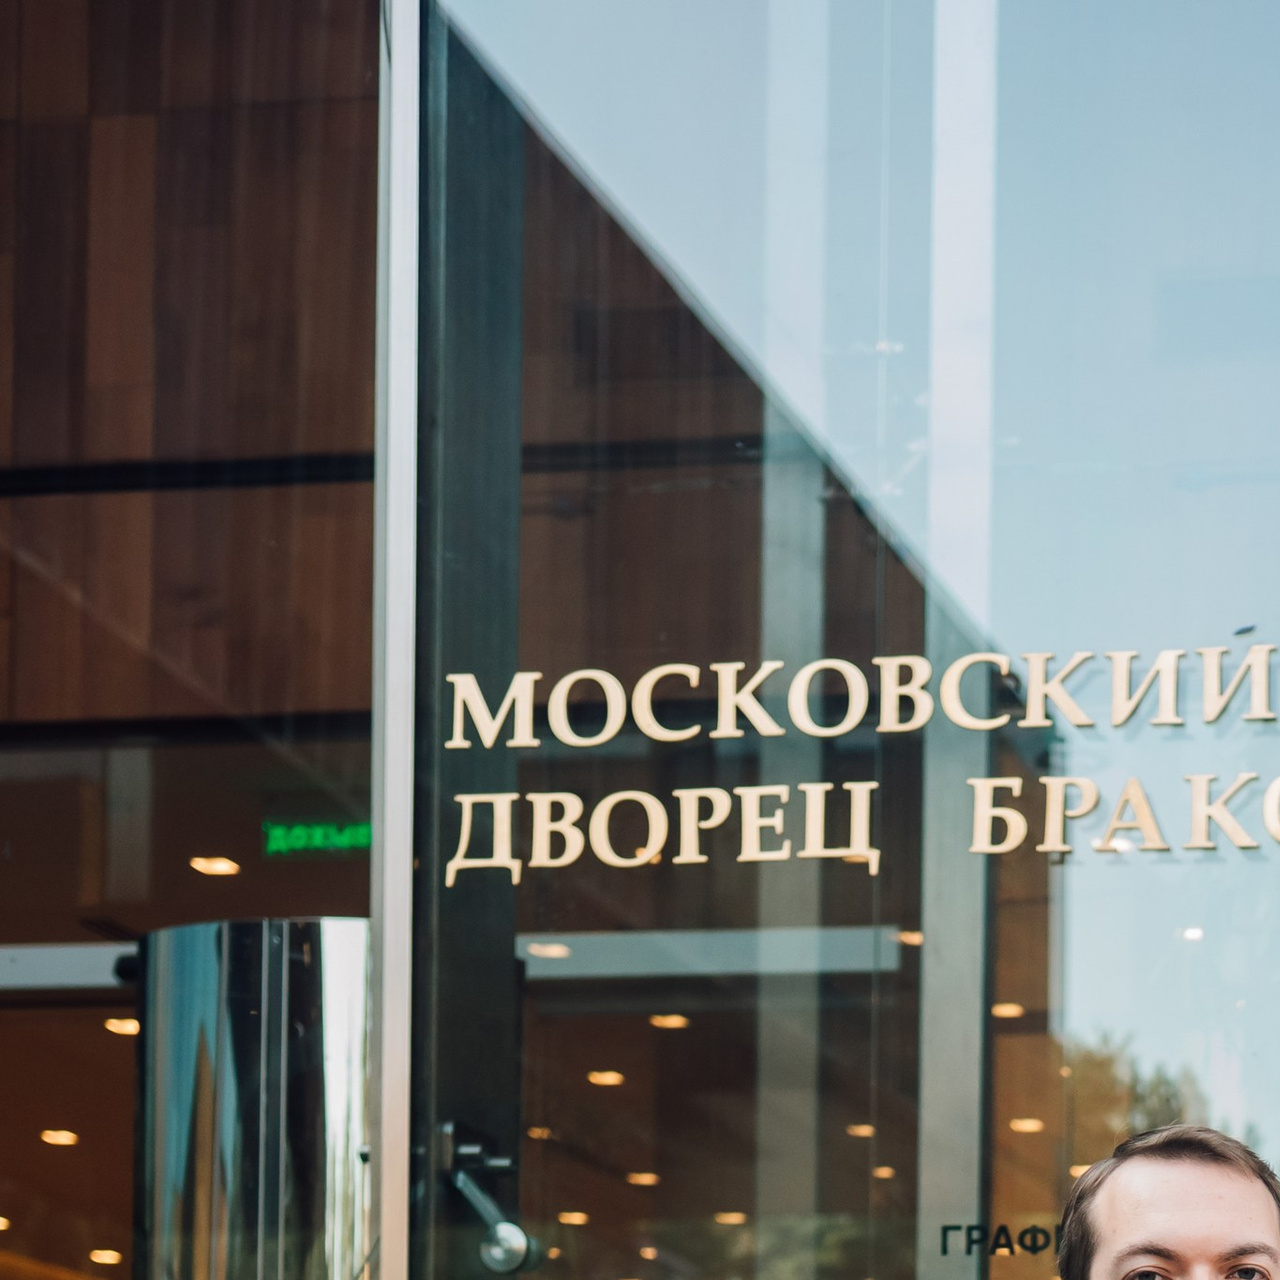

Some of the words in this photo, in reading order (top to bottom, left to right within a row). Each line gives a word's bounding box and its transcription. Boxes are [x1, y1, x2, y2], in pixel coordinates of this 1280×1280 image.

[443, 624, 1279, 750] МОСКОВСКИЙ
[444, 780, 881, 888] ДВОРЕЦ
[941, 1225, 1062, 1256] ГРАФ
